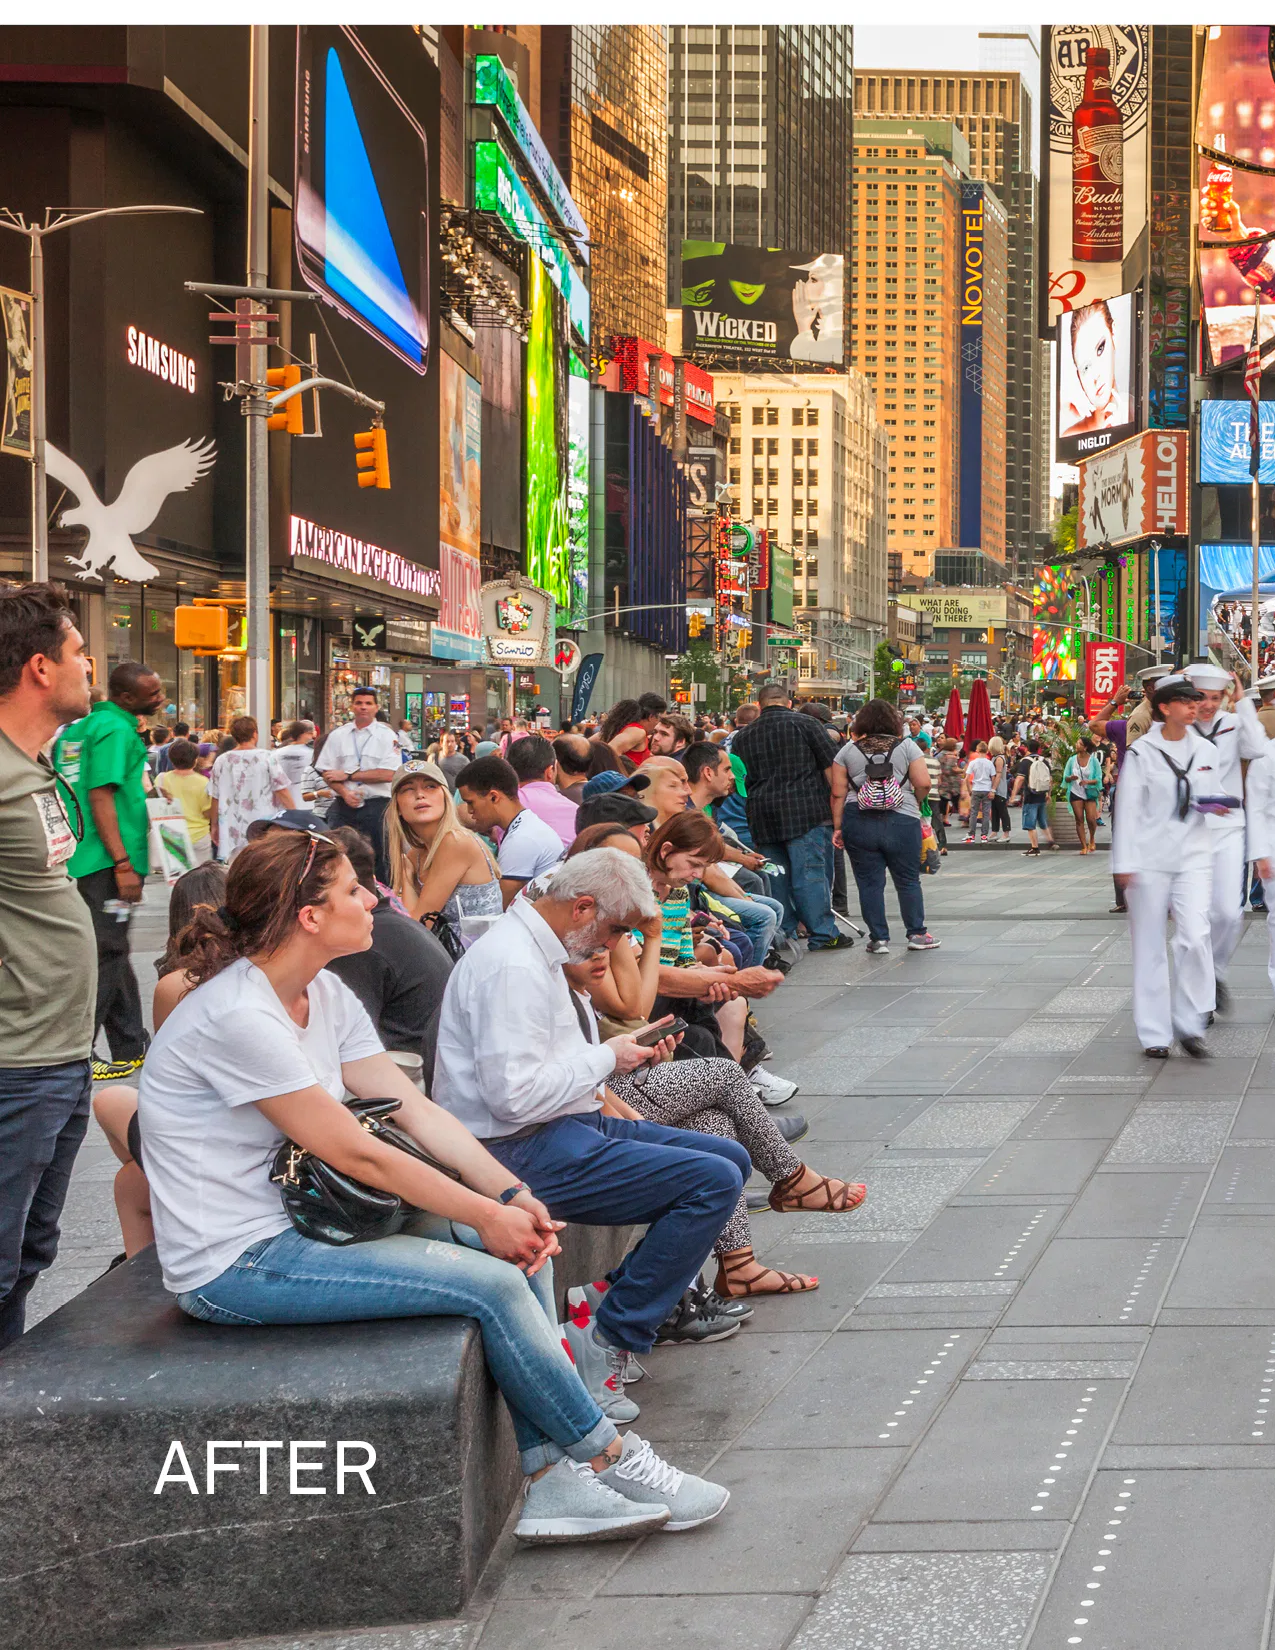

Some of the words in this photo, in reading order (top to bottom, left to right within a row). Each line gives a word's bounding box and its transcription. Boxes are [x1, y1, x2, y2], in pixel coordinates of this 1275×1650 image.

[962, 199, 984, 326] NOVOTEL
[693, 310, 777, 343] WICKED
[127, 325, 196, 394] SAMSUNG
[688, 382, 711, 406] PLAZA
[1078, 434, 1111, 450] INGLOT
[1101, 478, 1134, 508] MORMON
[1157, 435, 1177, 529] HELLO!
[920, 599, 943, 607] WHAT
[944, 599, 960, 607] ARE
[944, 614, 973, 623] THERE?
[1094, 647, 1117, 693] tkts
